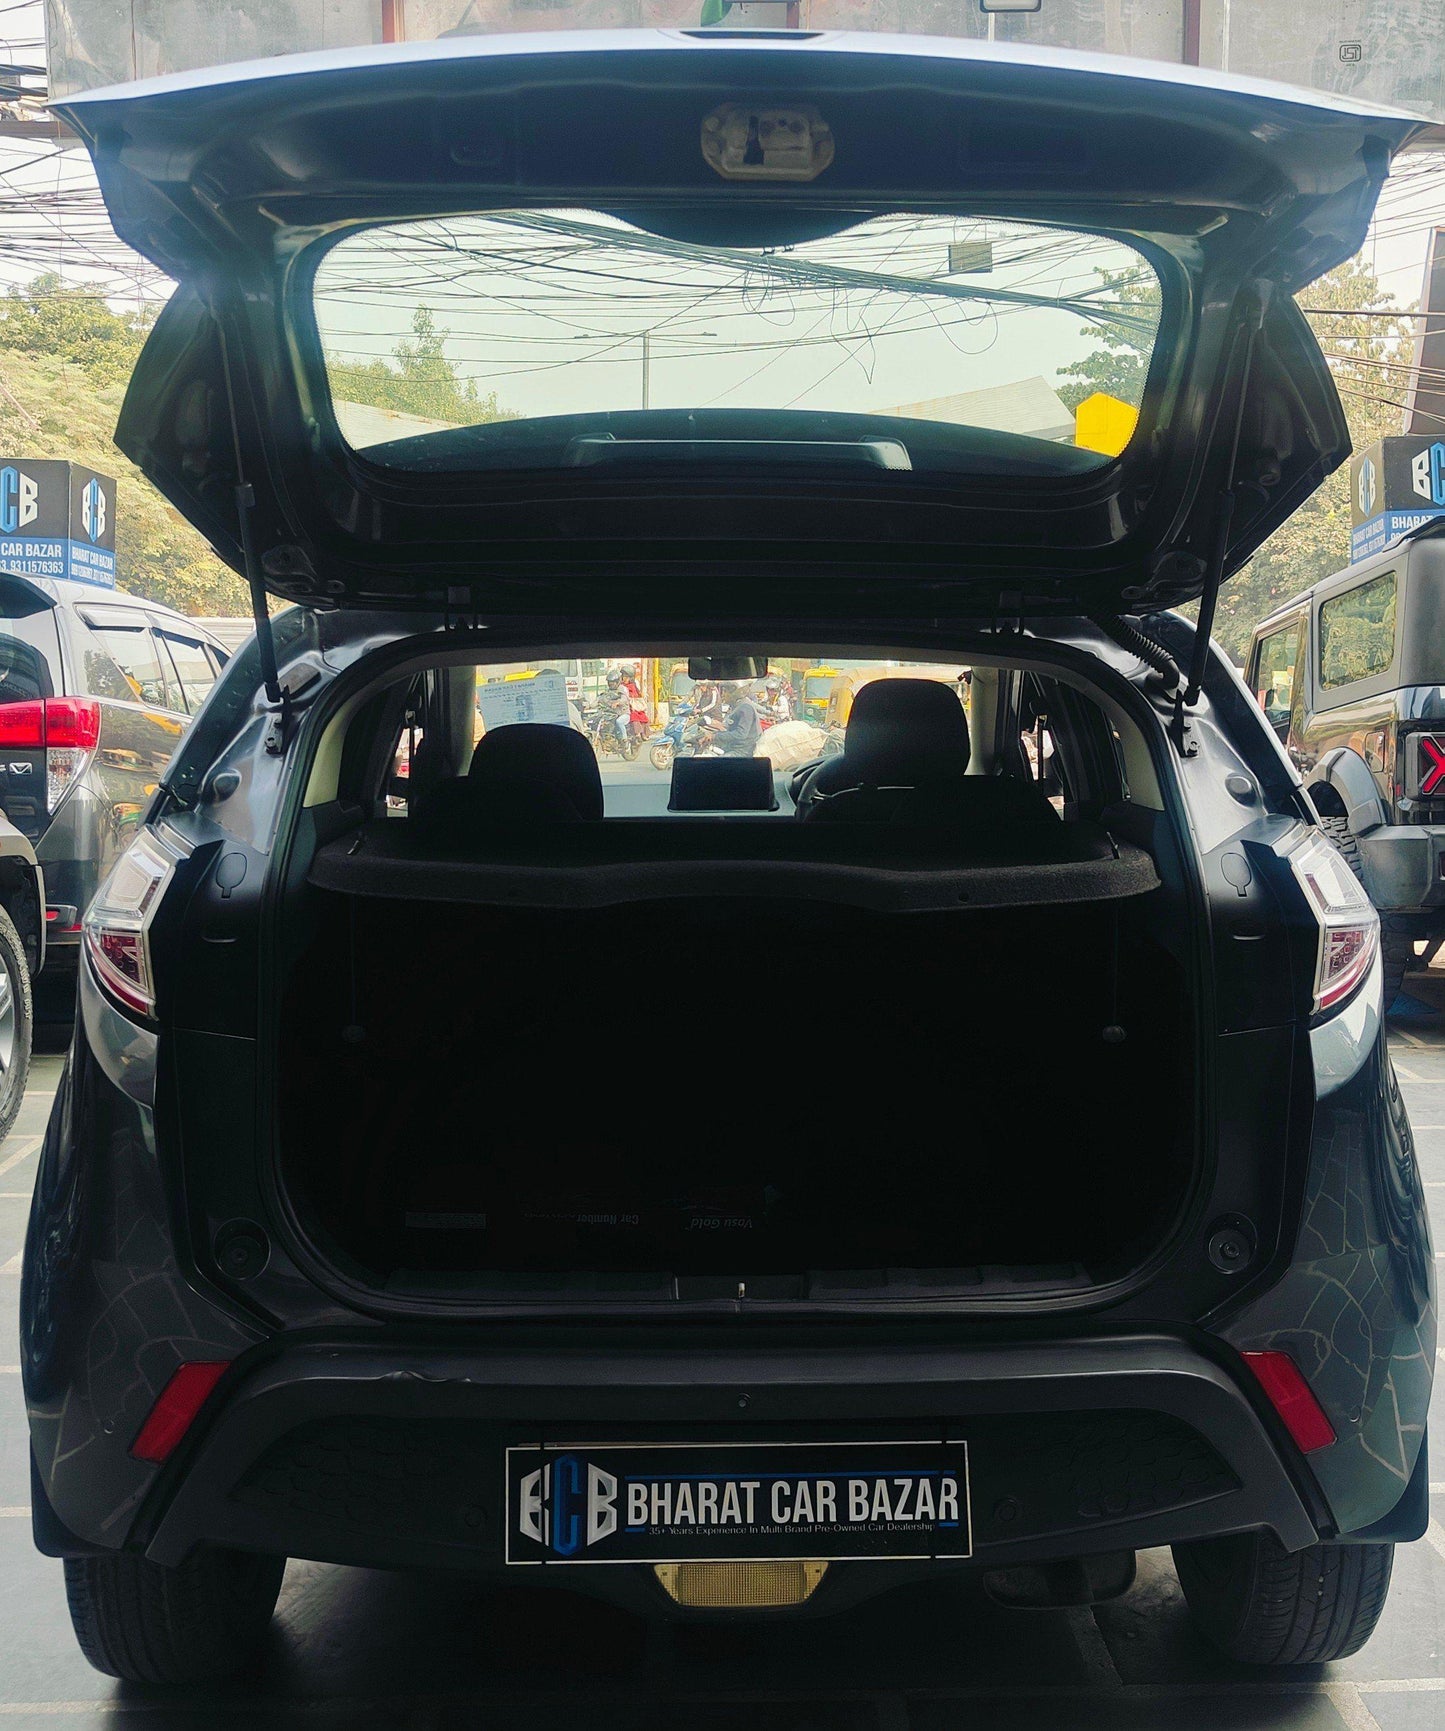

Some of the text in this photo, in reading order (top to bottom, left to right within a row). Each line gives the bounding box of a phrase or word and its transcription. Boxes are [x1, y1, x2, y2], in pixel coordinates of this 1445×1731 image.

[1412, 442, 1445, 506] BC
[0, 466, 38, 533] CB
[82, 478, 106, 542] BCB
[1, 542, 62, 559] CAR BAZAR
[10, 560, 63, 574] 9311576363
[627, 1477, 959, 1526] BHARAT CAR BAZAR
[669, 1527, 694, 1535] Years
[696, 1526, 747, 1536] Experience
[749, 1526, 758, 1534] In
[761, 1525, 783, 1534] Multi
[784, 1524, 812, 1533] Brand
[814, 1524, 865, 1533] Pre-Owned
[868, 1523, 884, 1532] Car
[887, 1522, 935, 1532] Dealership
